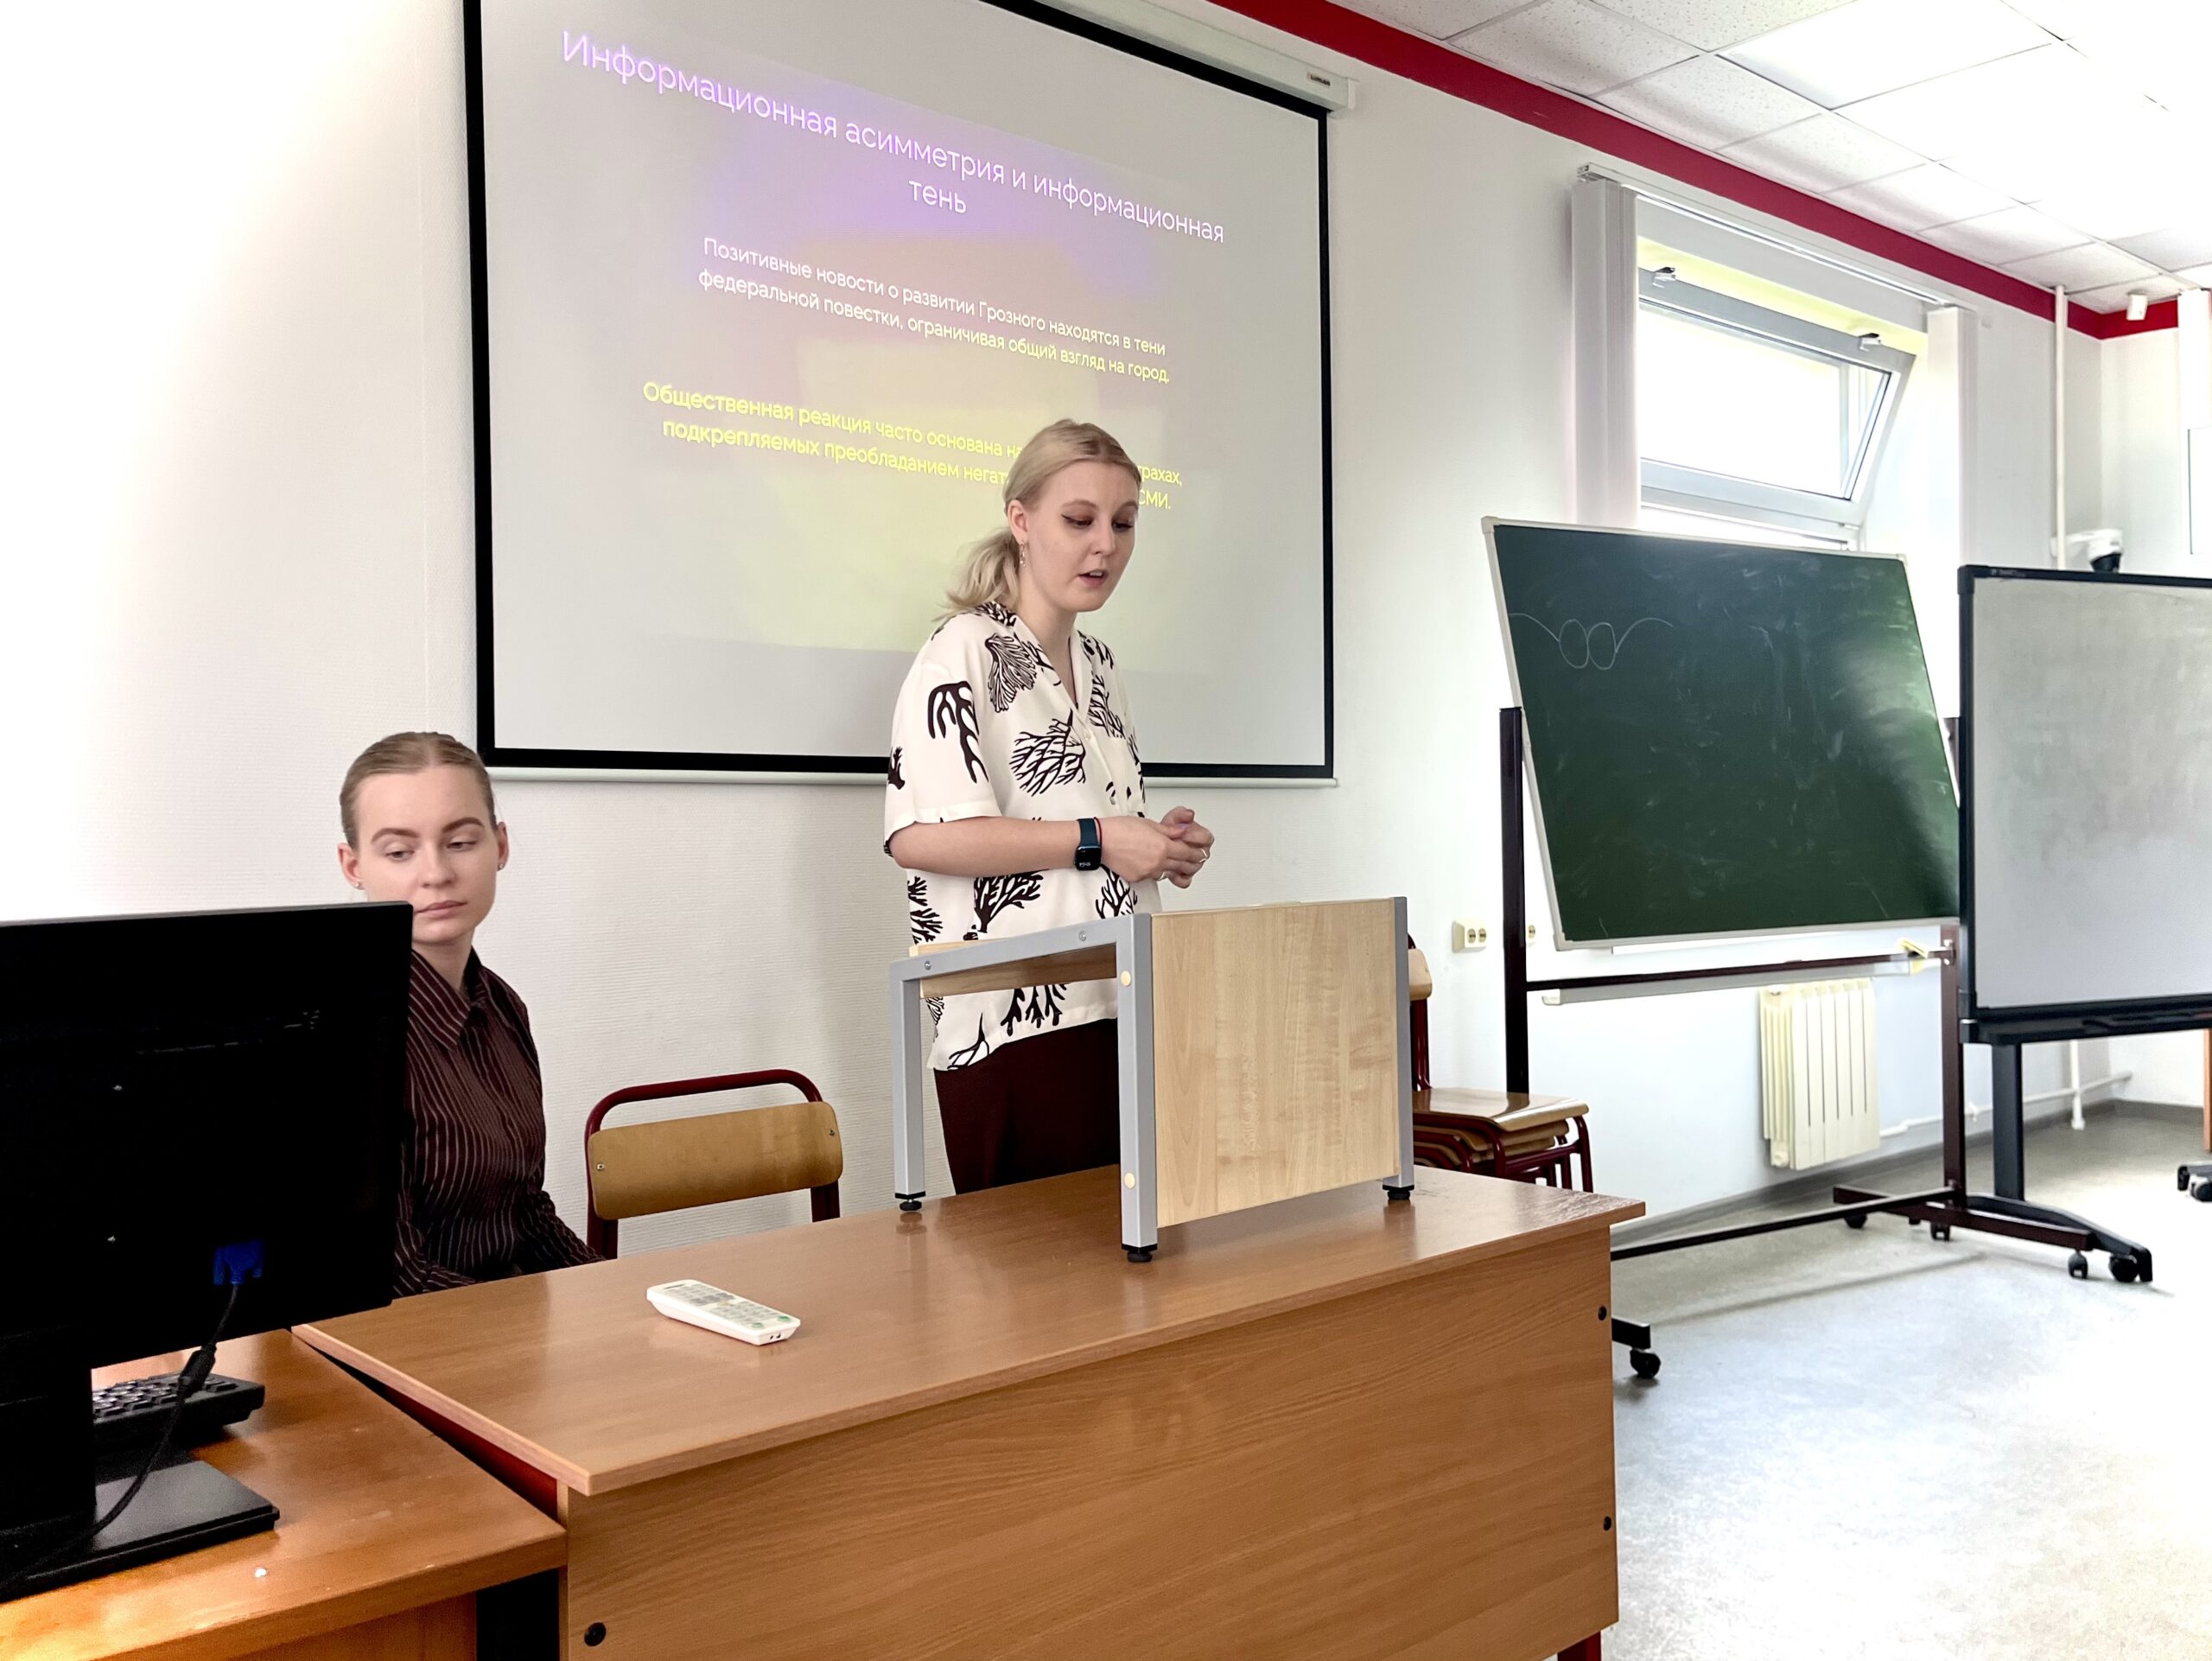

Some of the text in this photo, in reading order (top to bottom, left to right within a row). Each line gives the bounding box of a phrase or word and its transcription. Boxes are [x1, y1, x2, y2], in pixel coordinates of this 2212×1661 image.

[563, 29, 1224, 243] Информационная асимметрия и информационная
[909, 179, 967, 214] тень
[698, 269, 1170, 384] федеральной повестки, ограничивая общий взгляд на город.
[703, 238, 1166, 356] Позитивные новости о развитии Грозного находятся в тени
[643, 381, 794, 421] Общественная
[798, 406, 872, 435] реакция
[876, 421, 923, 443] часто
[926, 431, 1003, 456] основана
[663, 421, 820, 456] подкрепляемых
[824, 442, 959, 478] преобладанием
[963, 466, 1009, 485] негат
